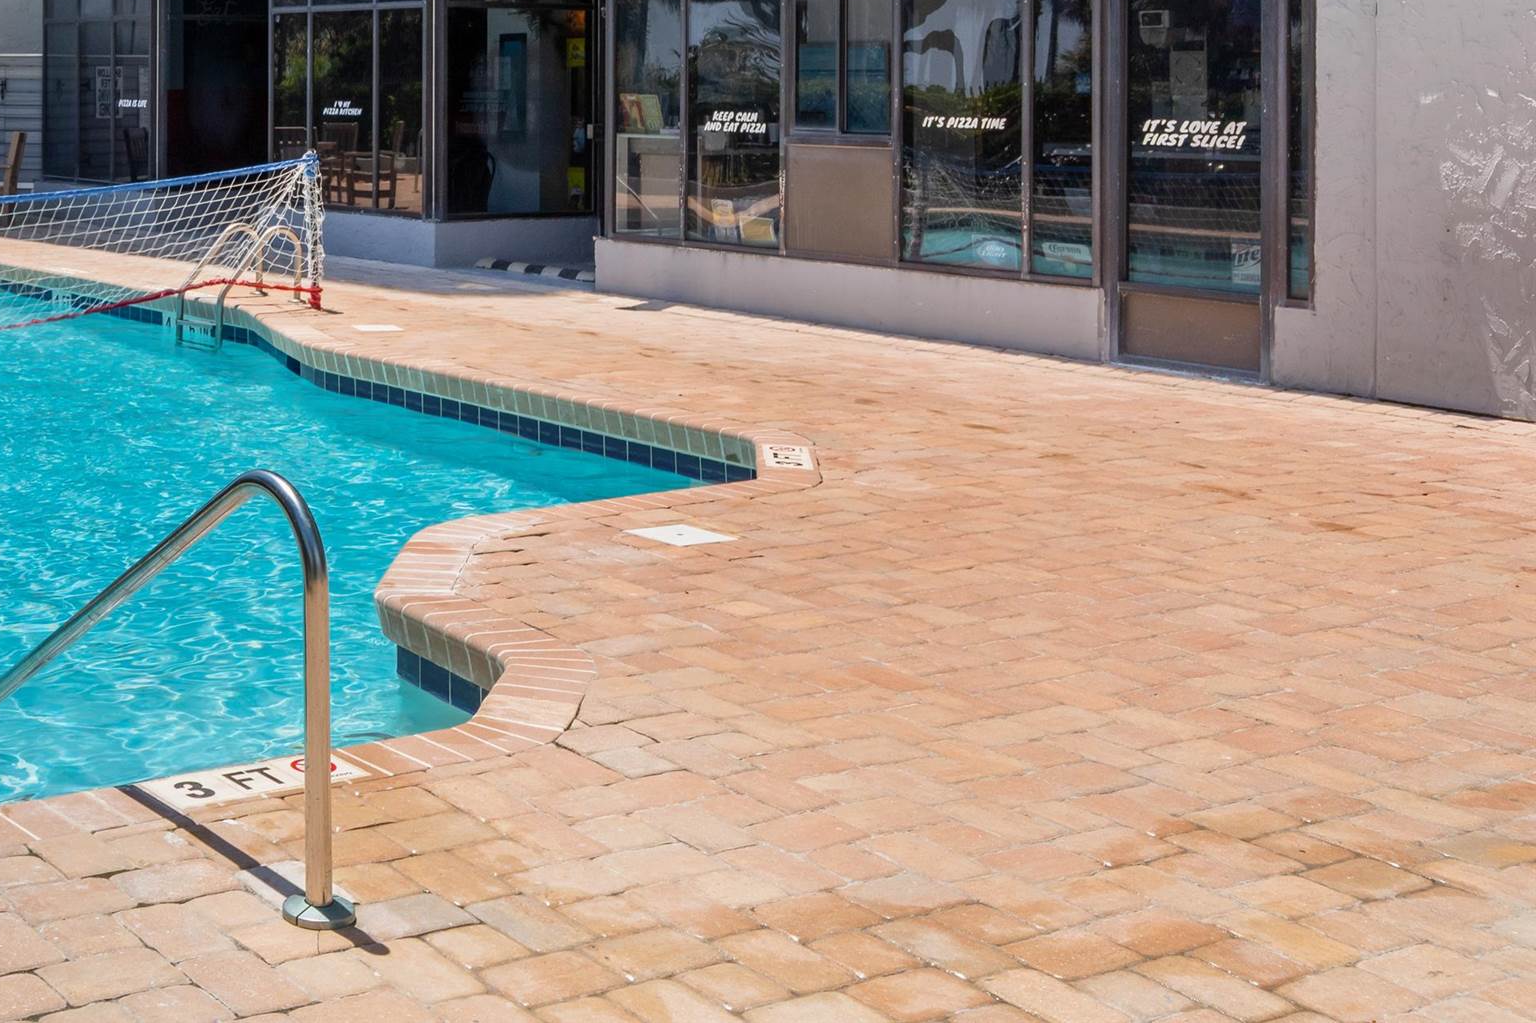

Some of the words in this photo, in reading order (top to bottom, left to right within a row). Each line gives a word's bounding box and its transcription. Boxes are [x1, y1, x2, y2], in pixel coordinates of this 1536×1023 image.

[712, 110, 734, 121] KEEP
[735, 112, 758, 122] CALM
[922, 116, 945, 128] IT'S
[946, 117, 978, 129] PIZZA
[981, 117, 1007, 130] TIME
[704, 121, 722, 131] AND
[723, 122, 740, 133] EAT
[740, 123, 767, 133] PIZZA
[1142, 119, 1177, 133] IT'S
[1179, 120, 1221, 134] LOVE
[1223, 121, 1247, 135] AT
[1142, 133, 1188, 147] FIRST
[1190, 134, 1246, 149] SLICE!
[174, 781, 216, 799] 3
[222, 767, 284, 790] FT
